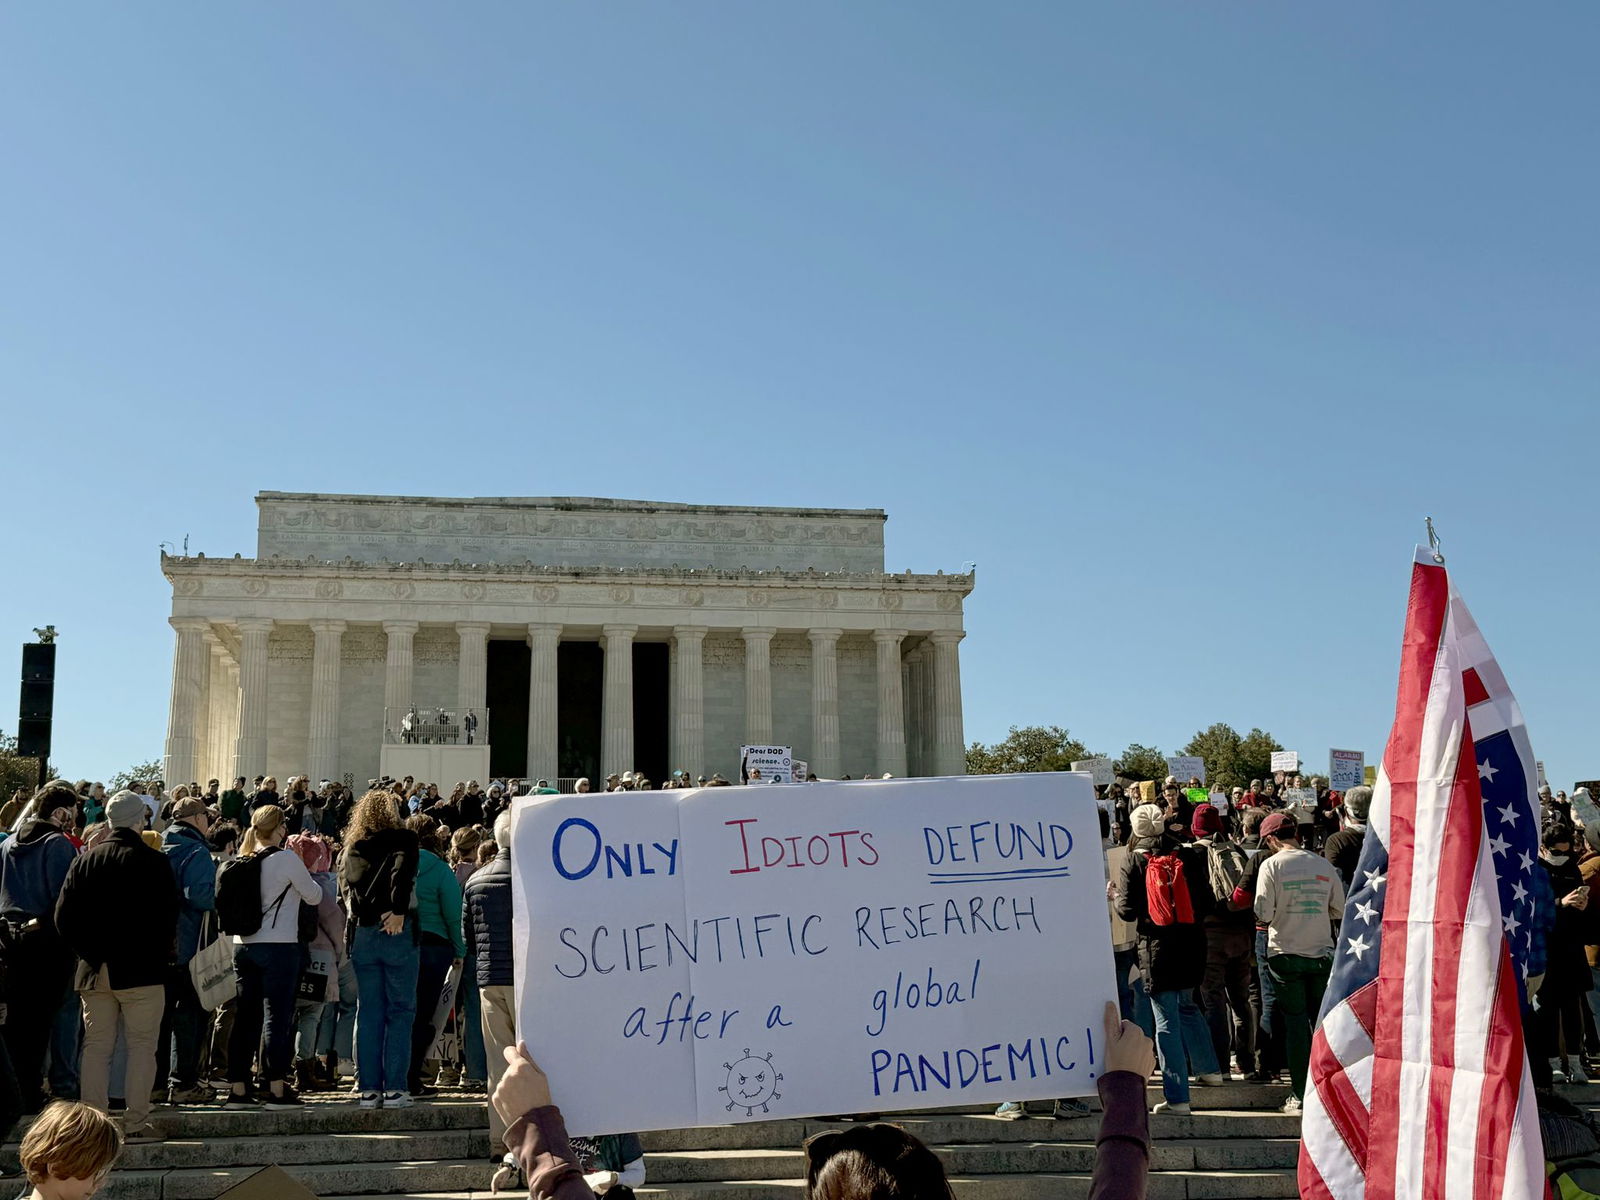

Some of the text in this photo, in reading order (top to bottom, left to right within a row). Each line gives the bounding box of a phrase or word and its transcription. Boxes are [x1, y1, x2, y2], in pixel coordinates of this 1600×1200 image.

[552, 817, 1073, 881] ONLY IDIOTS DEFUND
[555, 896, 1041, 978] SCIENTIFIC RESEARCH
[623, 959, 980, 1045] after a global
[871, 1028, 1095, 1096] PANDEMIC!
